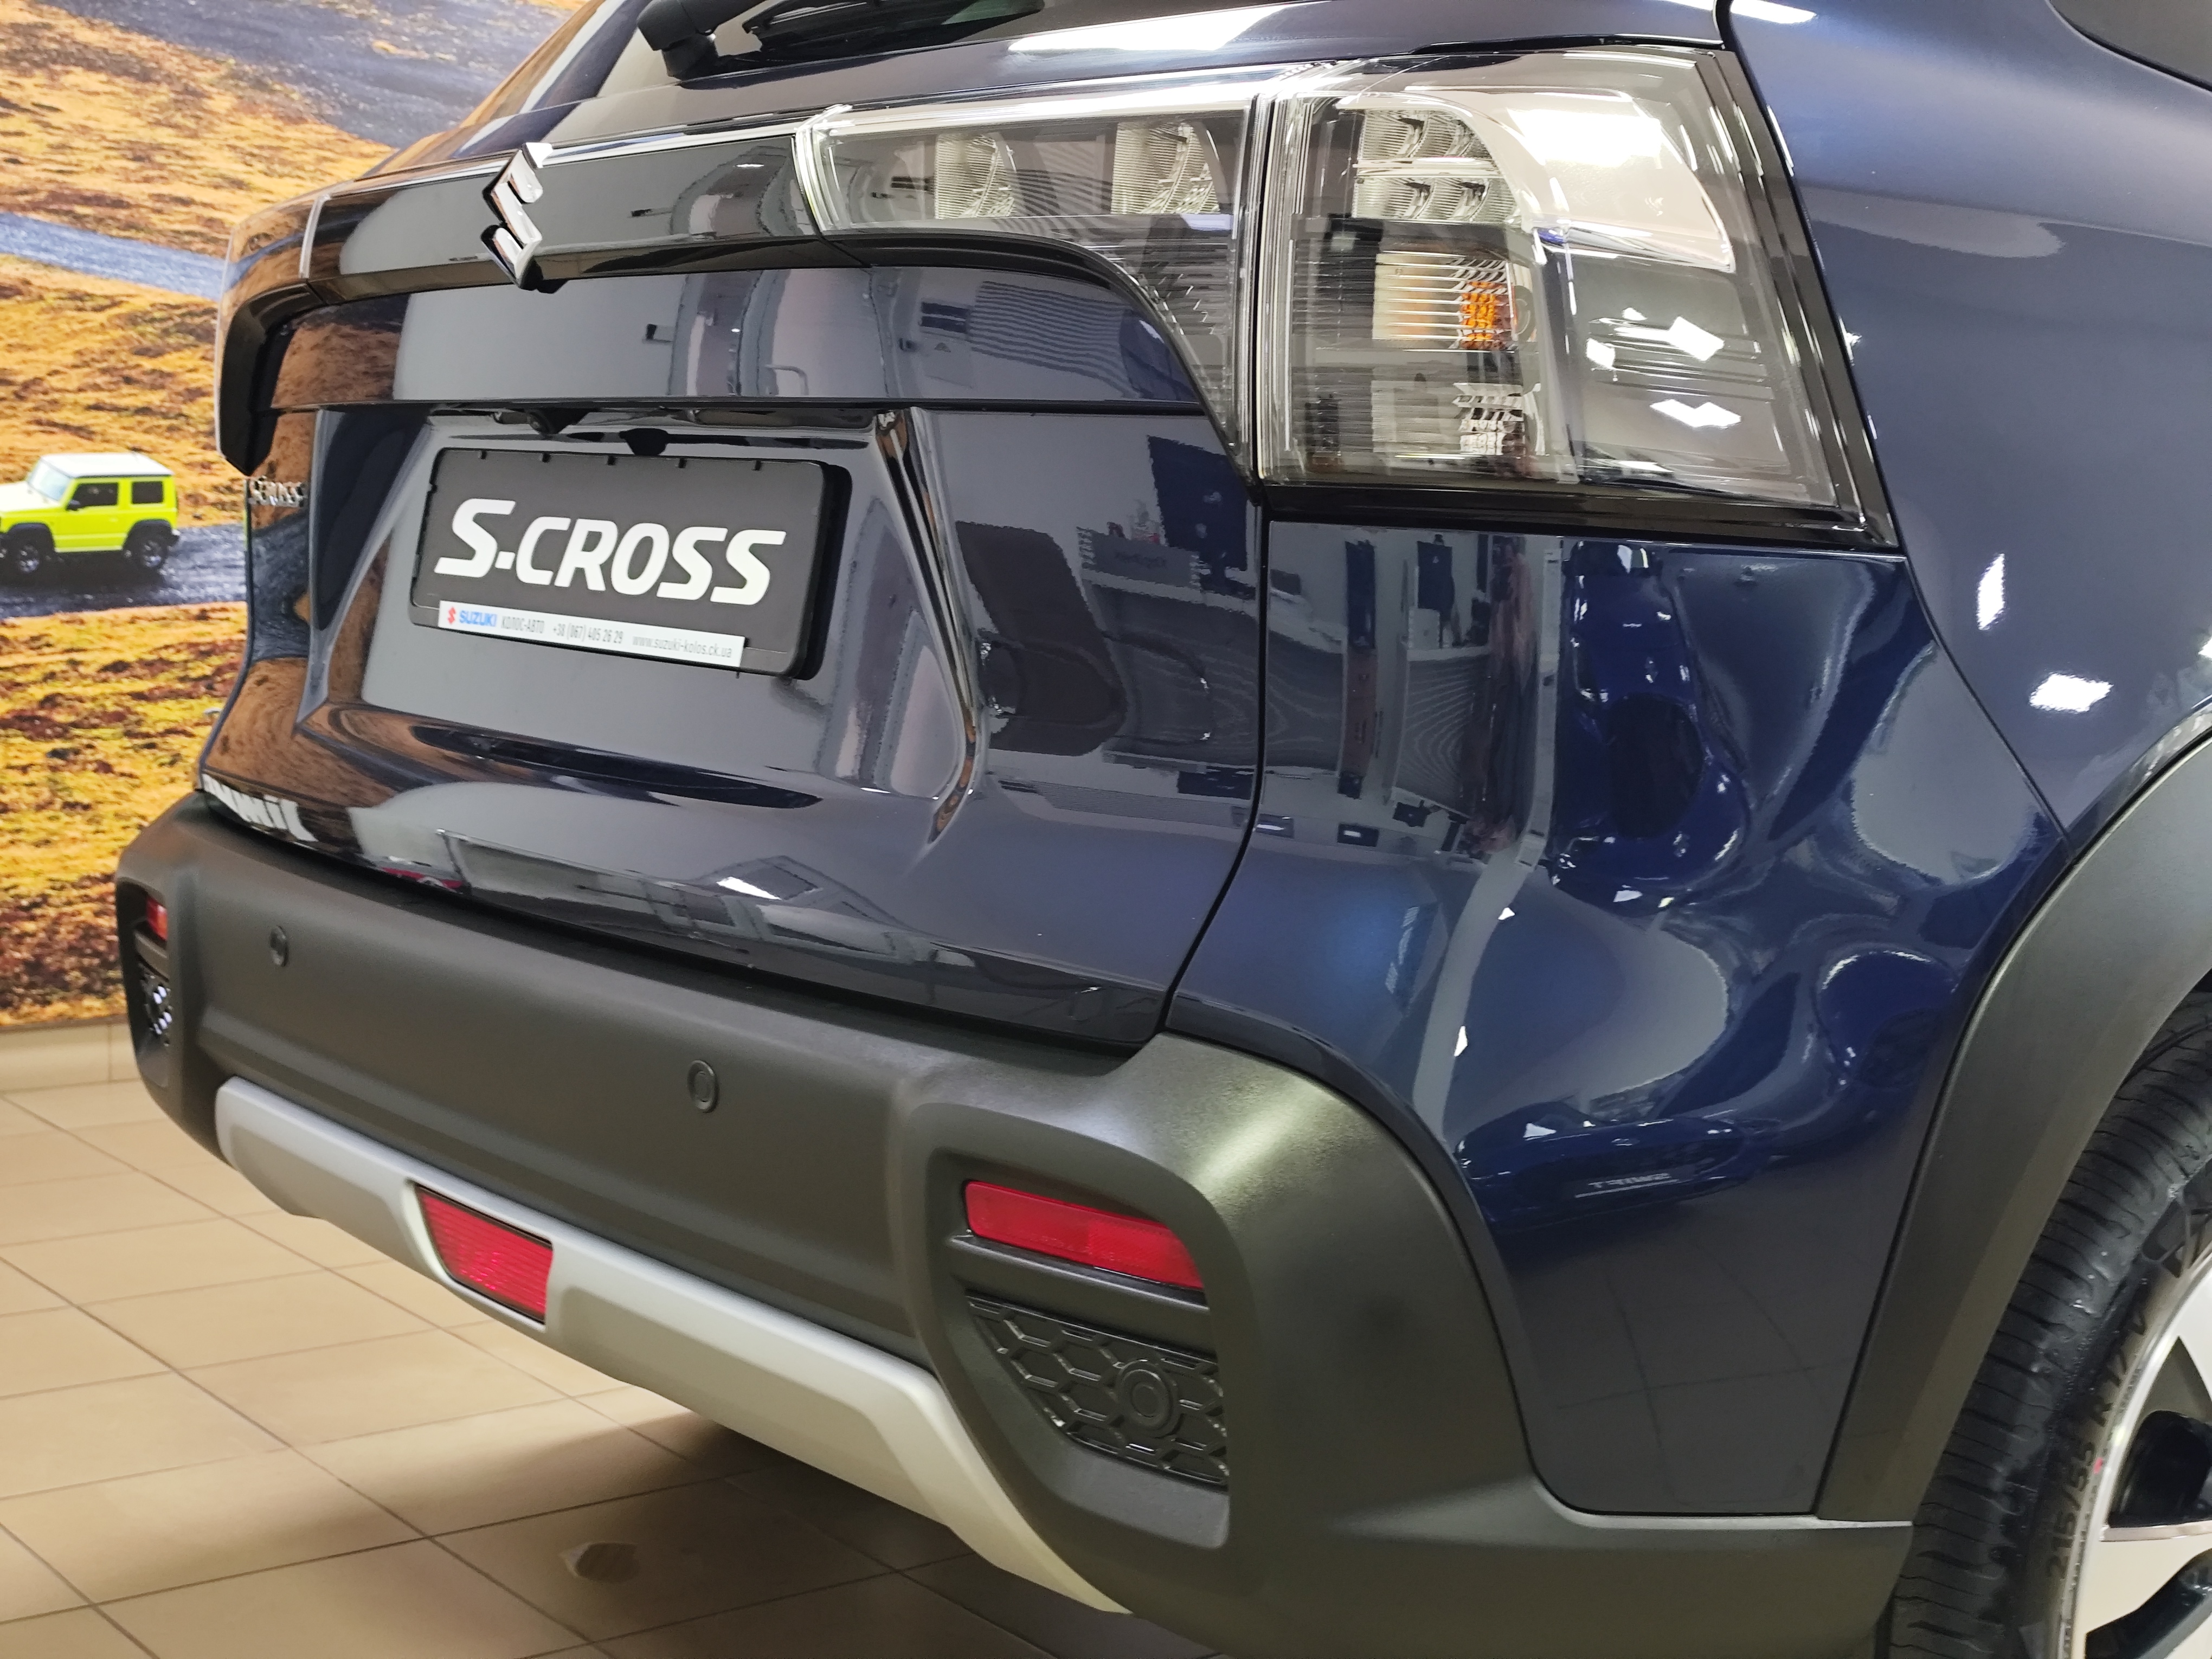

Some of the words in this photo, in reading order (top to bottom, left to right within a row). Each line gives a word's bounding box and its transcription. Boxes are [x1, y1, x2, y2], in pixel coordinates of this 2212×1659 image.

[434, 497, 787, 606] S-CROSS
[459, 609, 497, 627] SUZUKI
[553, 622, 565, 637] +38
[602, 629, 612, 642] 26
[613, 631, 623, 644] 29
[632, 635, 732, 658] www.suzuki-kolos.ck.ua
